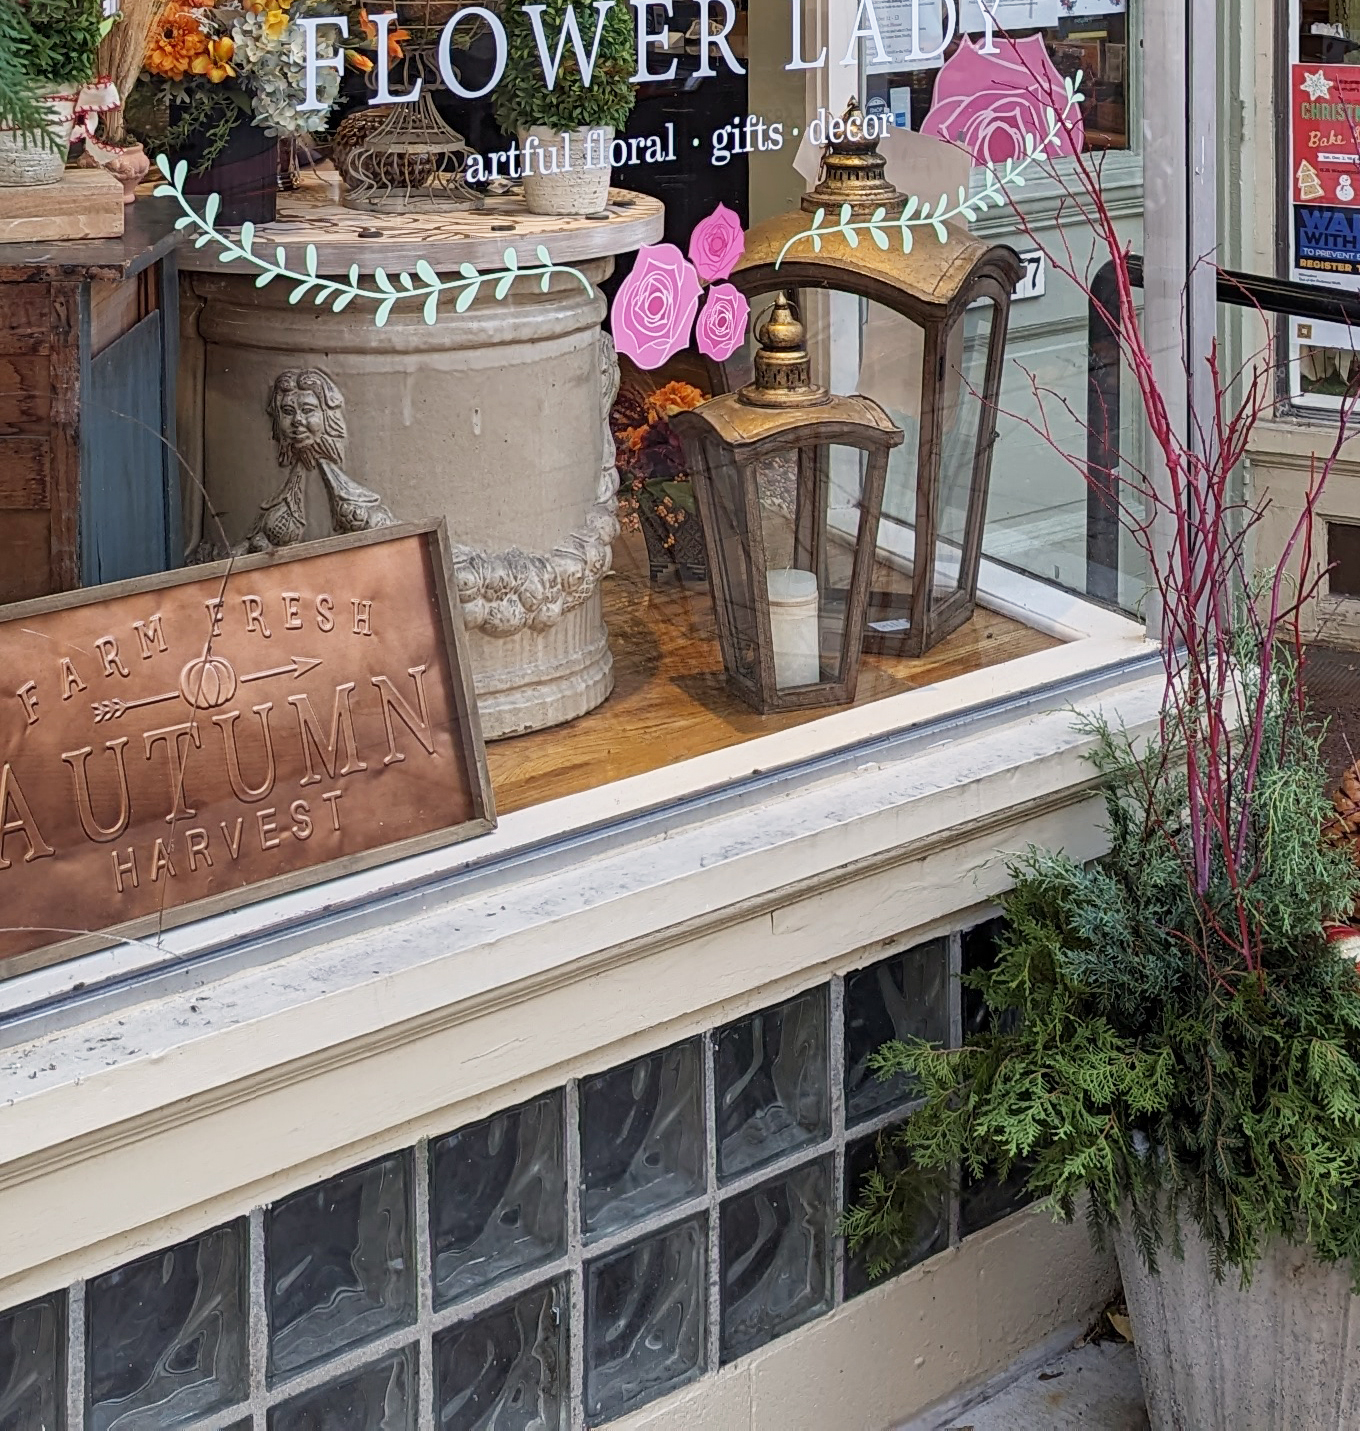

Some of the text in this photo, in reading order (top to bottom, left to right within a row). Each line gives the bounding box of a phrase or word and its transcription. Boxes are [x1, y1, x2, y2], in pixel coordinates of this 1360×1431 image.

[463, 107, 894, 184] artful floral gifts decor
[1308, 129, 1346, 148] Bake
[1304, 231, 1354, 250] WITH
[1302, 247, 1315, 256] TO
[1315, 250, 1355, 260] PREVENT
[1299, 258, 1352, 272] REGISTER
[15, 591, 374, 726] FARM FRESH
[109, 790, 344, 894] HARVEST
